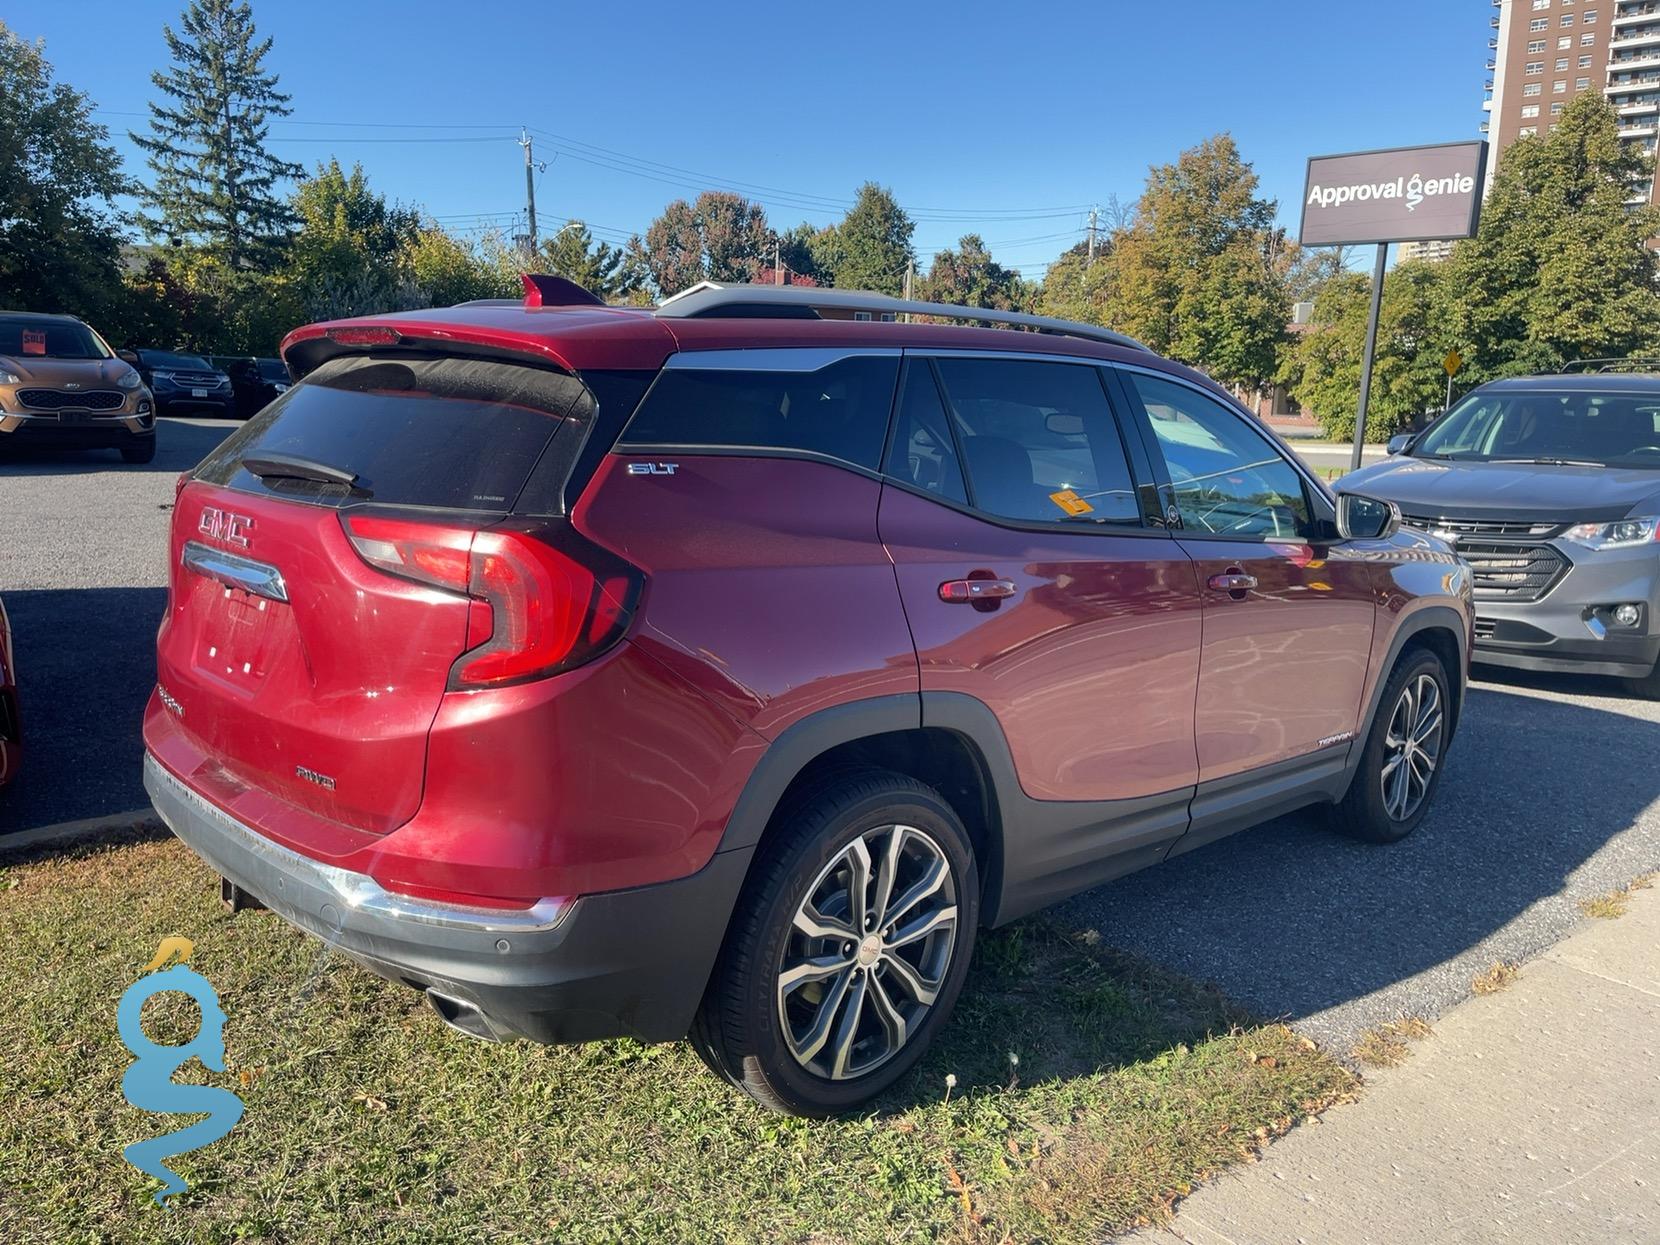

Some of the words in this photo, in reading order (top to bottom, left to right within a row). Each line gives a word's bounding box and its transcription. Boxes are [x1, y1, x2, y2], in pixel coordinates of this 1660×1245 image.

[1307, 177, 1403, 208] Approval
[628, 462, 679, 475] SLT
[198, 506, 252, 549] GMC
